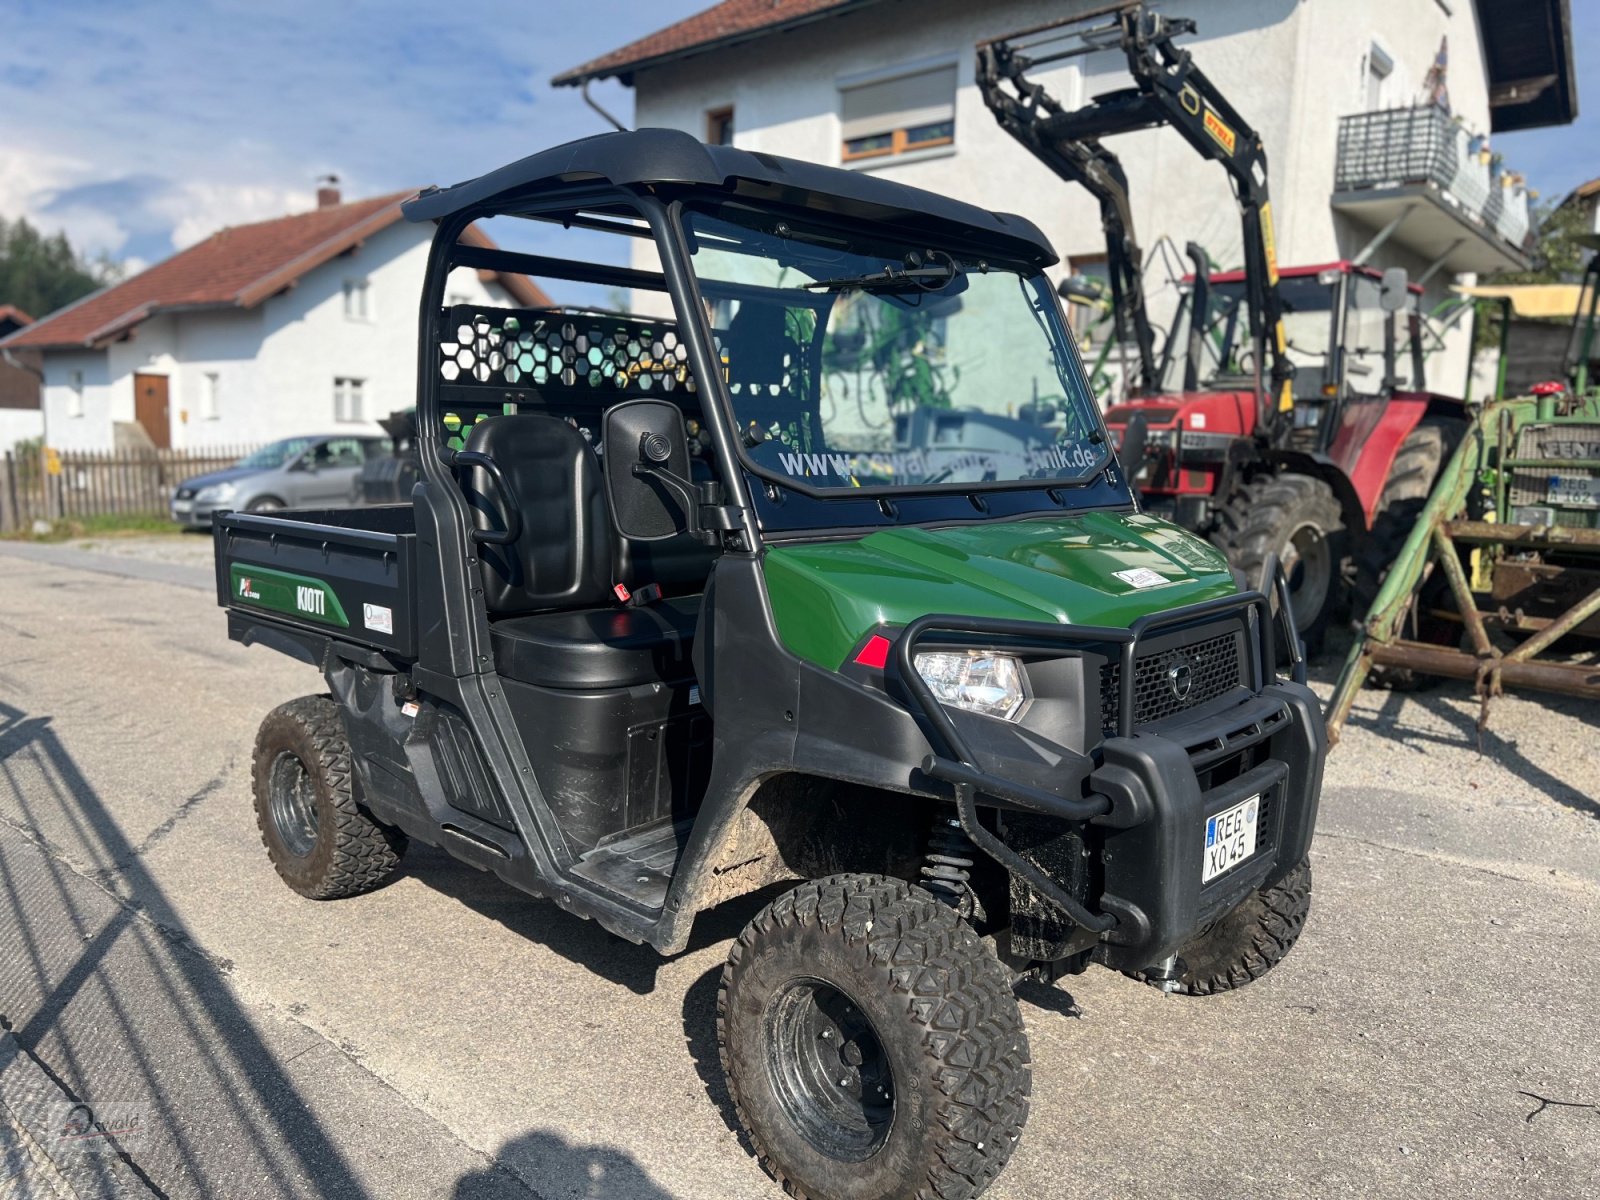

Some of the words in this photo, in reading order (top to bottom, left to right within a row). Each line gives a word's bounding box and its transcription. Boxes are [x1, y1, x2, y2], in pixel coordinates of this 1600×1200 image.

[297, 585, 325, 616] KIOTI
[1216, 808, 1243, 845] REG
[1209, 844, 1227, 875] XO
[1230, 833, 1246, 861] 45
